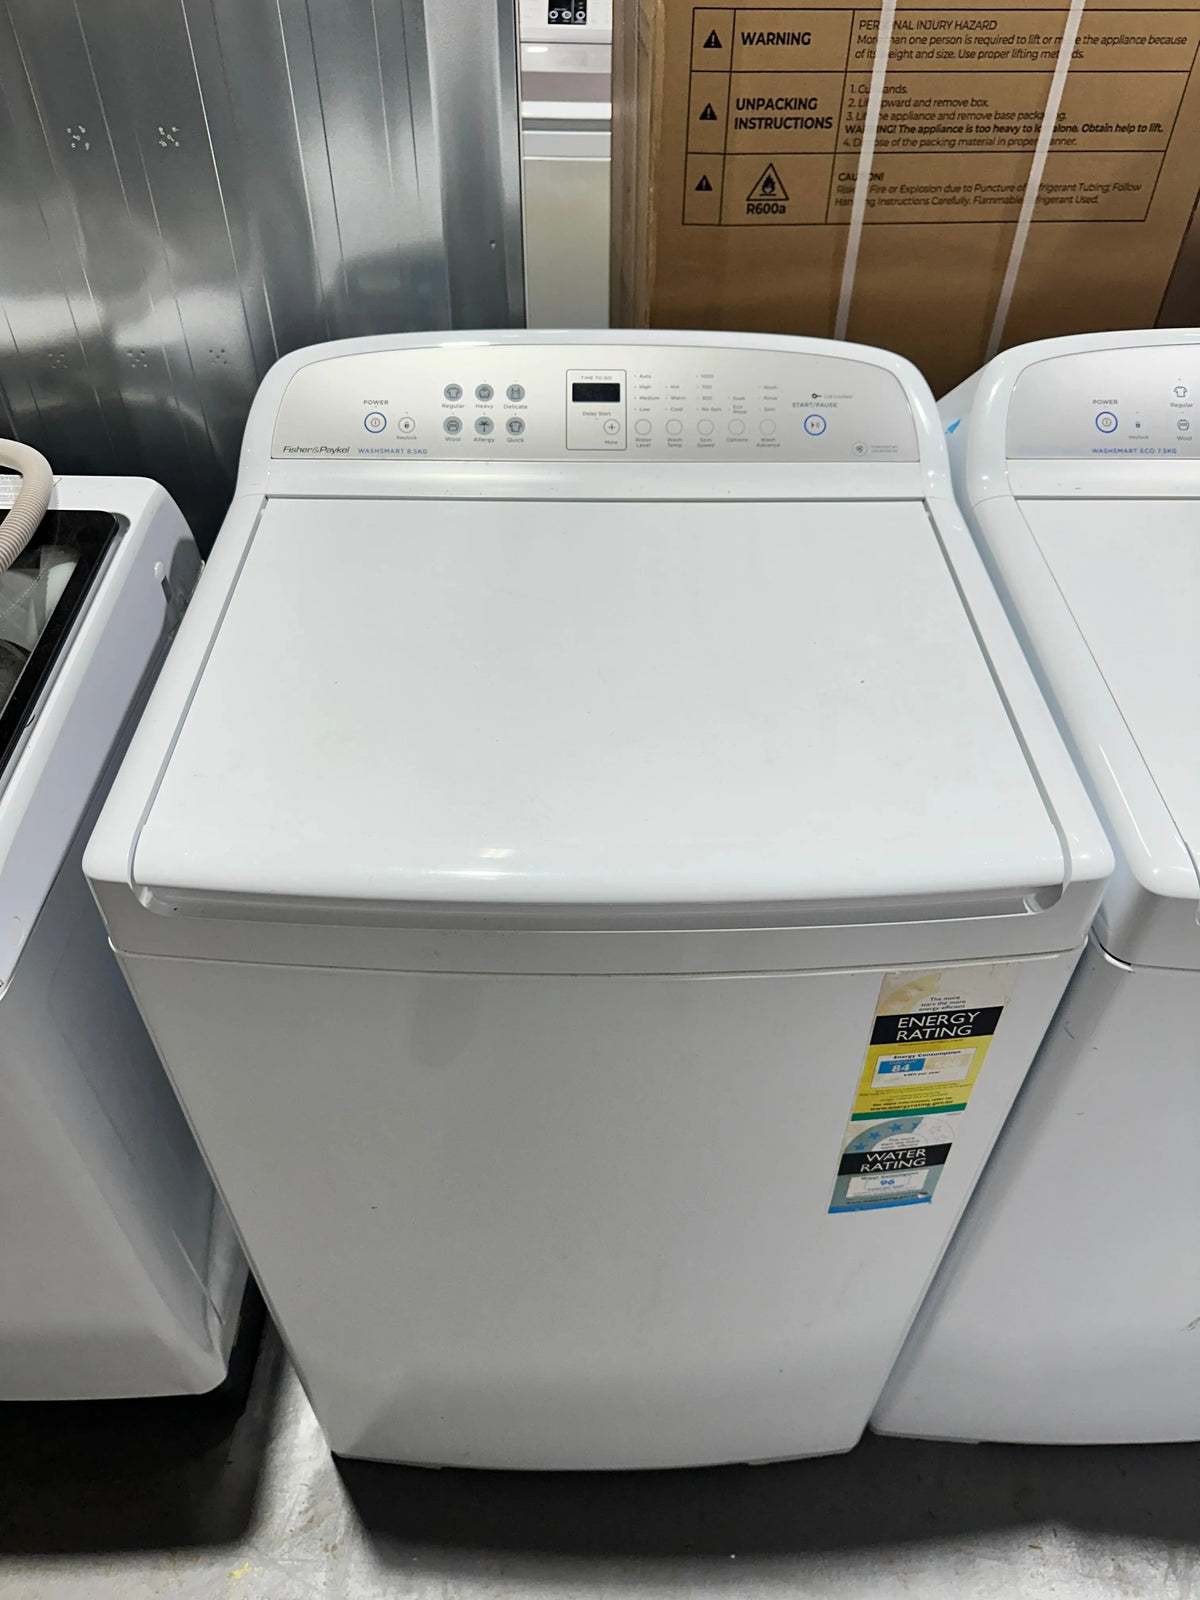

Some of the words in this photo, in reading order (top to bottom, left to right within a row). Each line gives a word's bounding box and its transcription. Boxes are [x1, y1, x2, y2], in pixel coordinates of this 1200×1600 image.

[859, 20, 914, 30] PERNAL
[916, 20, 952, 31] INJURY
[954, 20, 997, 31] HAZARD
[741, 32, 811, 46] WARNING
[857, 35, 878, 45] Mor
[909, 37, 927, 45] one
[929, 37, 962, 48] person
[965, 34, 972, 45] is
[974, 34, 1014, 48] required
[1016, 36, 1026, 45] to
[1028, 34, 1041, 45] lift
[1042, 37, 1053, 45] or
[1054, 37, 1081, 45] me
[1084, 35, 1099, 45] the
[1100, 34, 1146, 48] appliance
[1148, 35, 1188, 45] because
[855, 49, 866, 59] of
[888, 50, 913, 61] eight
[915, 50, 934, 59] and
[936, 50, 956, 59] size.
[958, 50, 975, 59] Use
[978, 52, 1010, 62] proper
[1012, 49, 1038, 61] lifting
[1040, 50, 1084, 59] metds.
[858, 84, 871, 94] Cu
[883, 84, 908, 94] ands.
[736, 98, 818, 111] UNPACKING
[881, 98, 912, 110] pward
[913, 98, 931, 108] and
[932, 100, 969, 108] remove
[890, 110, 936, 123] appliance
[938, 111, 955, 120] and
[957, 112, 992, 121] remove
[994, 110, 1015, 120] base
[734, 117, 833, 130] INSTRUCTIONS
[845, 124, 897, 134] WAING!
[900, 124, 916, 134] The
[918, 124, 963, 136] appliance
[965, 124, 973, 134] is
[976, 125, 991, 134] too
[992, 124, 1020, 136] heavy
[1023, 125, 1033, 133] to
[1082, 124, 1113, 133] Obtain
[1115, 124, 1135, 135] help
[1138, 125, 1147, 133] to
[854, 138, 890, 147] Dose
[891, 138, 902, 147] of
[902, 138, 917, 147] the
[919, 137, 955, 150] packing
[958, 136, 995, 147] material
[998, 136, 1006, 146] in
[1050, 138, 1077, 146] anner.
[888, 186, 898, 194] or
[900, 184, 942, 196] Explosion
[944, 184, 961, 193] due
[962, 184, 973, 193] to
[974, 184, 1016, 193] Puncture
[1112, 182, 1142, 192] Follow
[878, 196, 930, 206] Instructions
[746, 203, 786, 215] R600a
[283, 446, 351, 454] Fisher&Paykel
[898, 1011, 981, 1029] ENERGY
[896, 1025, 973, 1041] RATING
[918, 1050, 962, 1058] Consumption
[891, 1064, 910, 1072] 84
[866, 1149, 926, 1162] WATER
[860, 1158, 927, 1173] RATING
